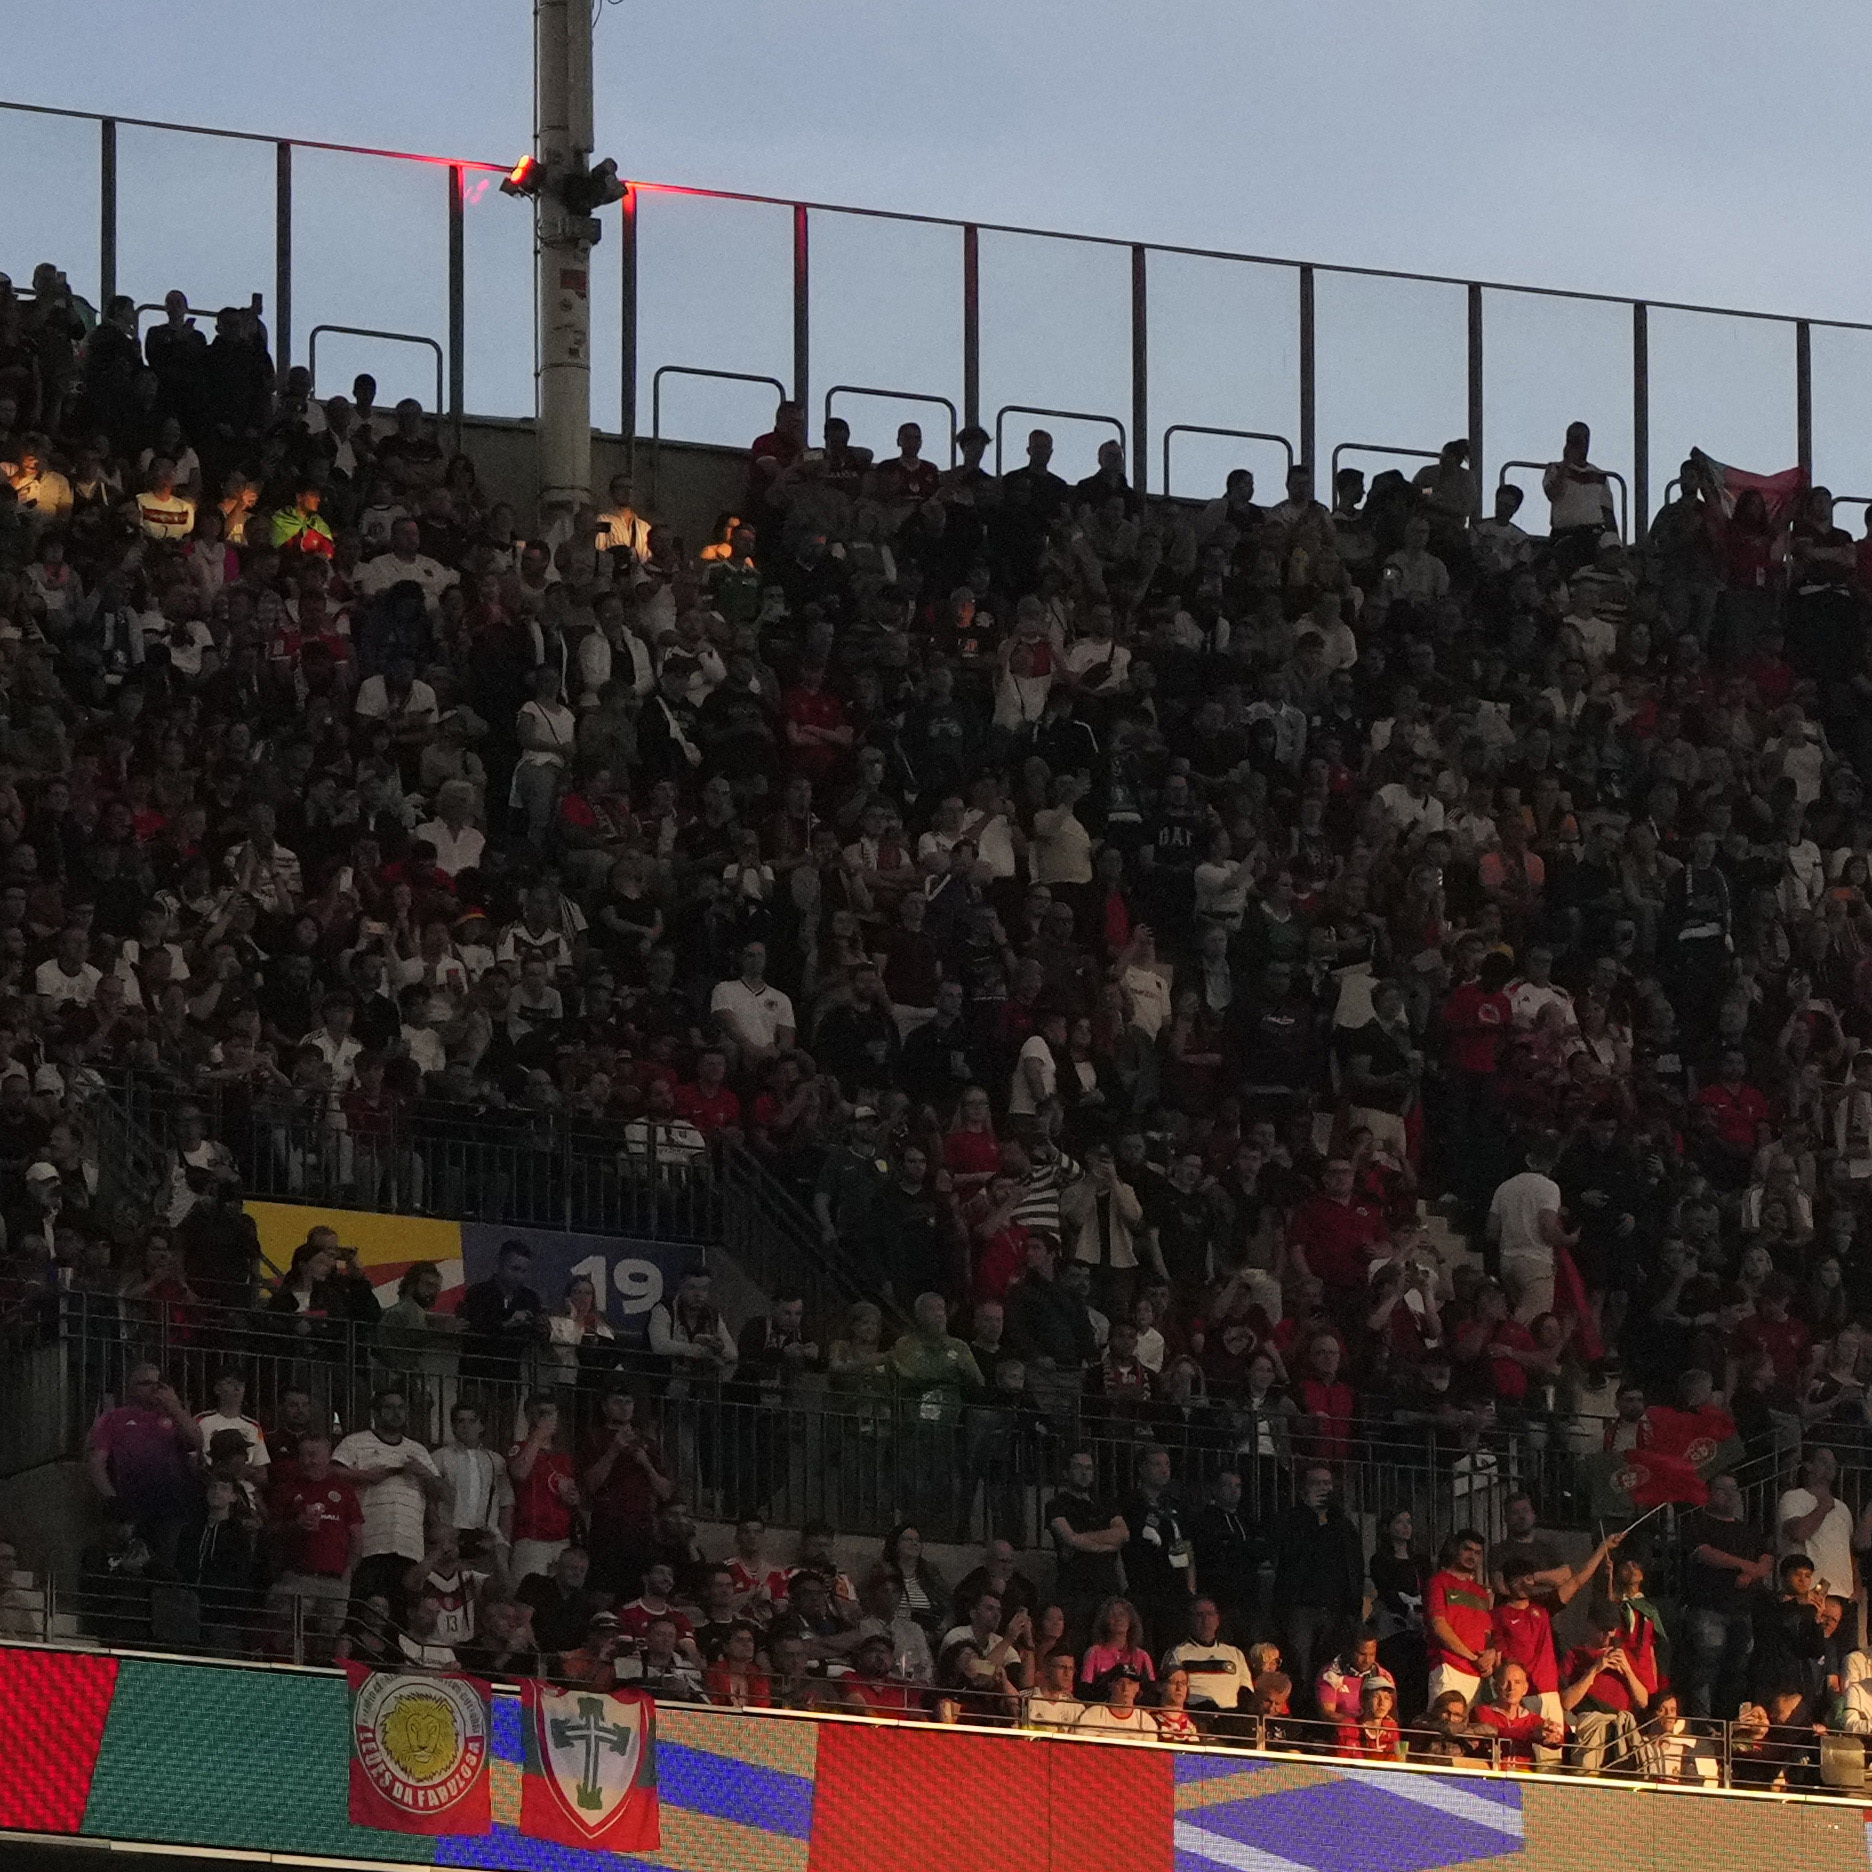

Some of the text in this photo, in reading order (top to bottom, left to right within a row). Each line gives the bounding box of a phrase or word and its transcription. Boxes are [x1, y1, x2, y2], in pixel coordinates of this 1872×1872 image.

[571, 1255, 664, 1315] 19
[446, 1615, 458, 1633] 13
[391, 1782, 415, 1802] DA
[416, 1740, 482, 1808] FABULOSA
